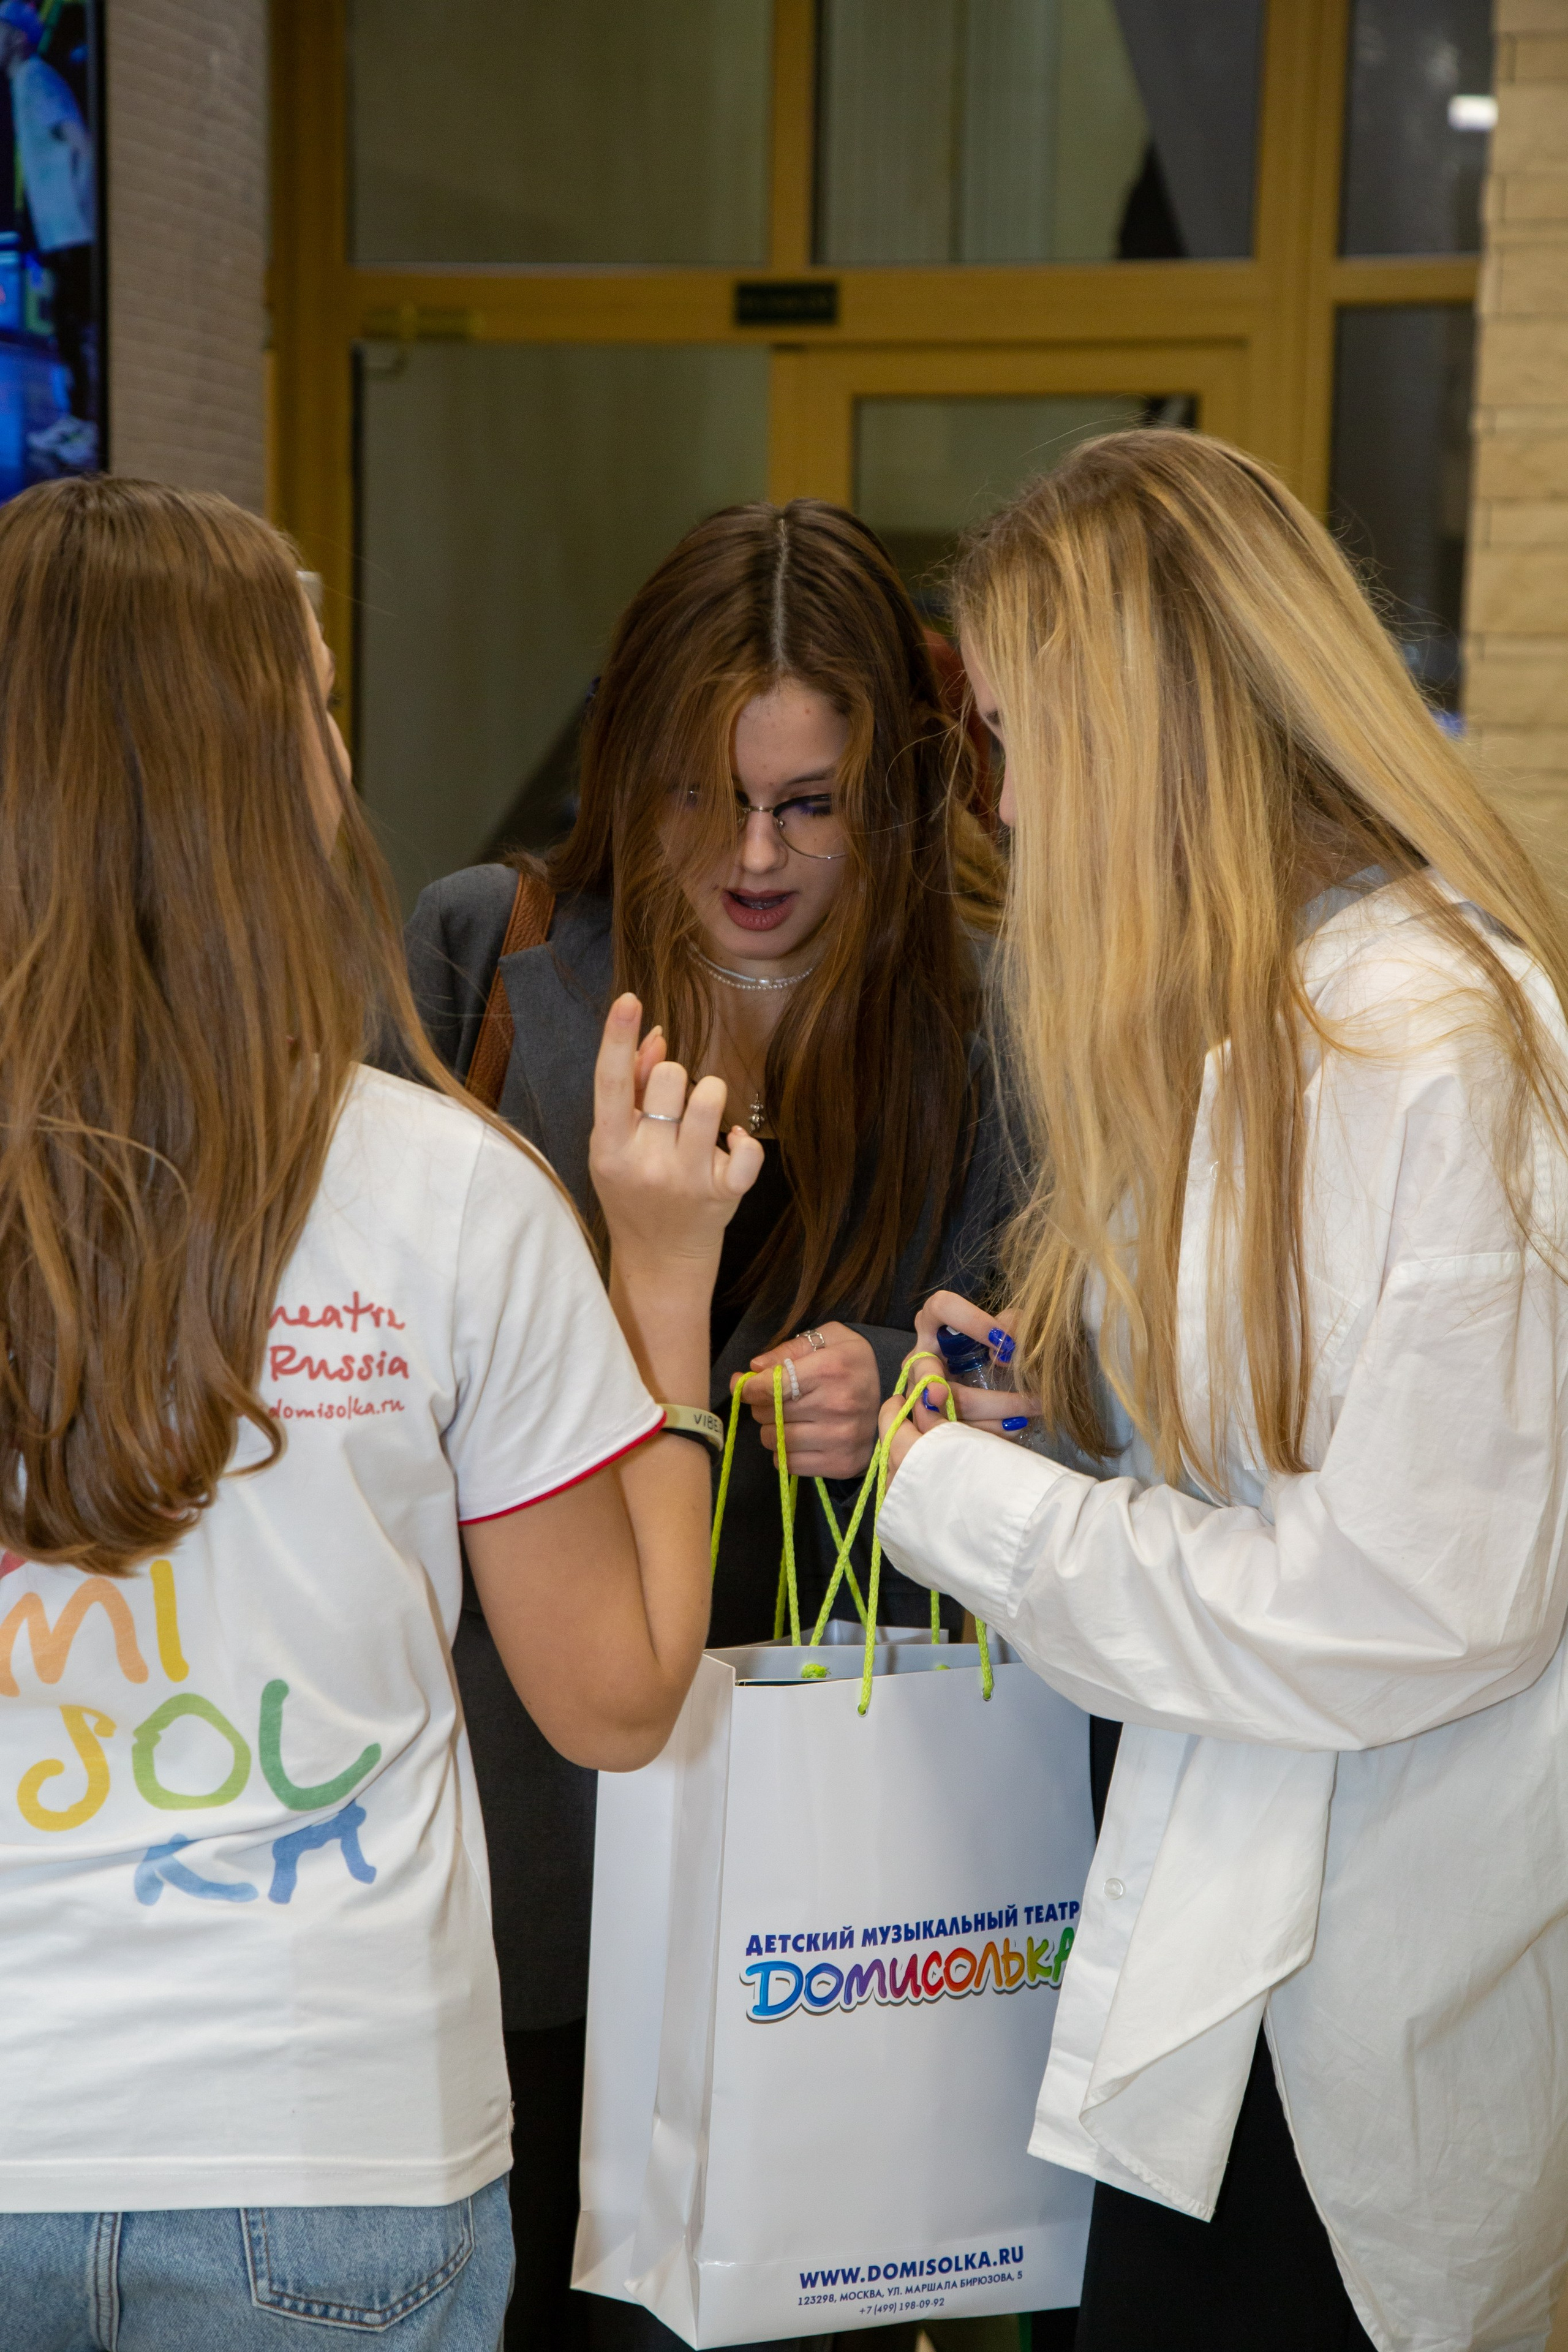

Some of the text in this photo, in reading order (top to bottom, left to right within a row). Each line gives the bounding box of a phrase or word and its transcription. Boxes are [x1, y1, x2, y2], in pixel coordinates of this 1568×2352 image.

[270, 1345, 409, 1382] Russia
[268, 1395, 405, 1420] domisolka.ru
[693, 1413, 722, 1434] VIBE
[17, 1679, 382, 1832] SOL
[745, 1900, 1080, 1956] ДЕТСКИЙ МУЗЫКАЛЬНЫЙ ТЕАТР
[799, 2245, 1024, 2289] WWW.DOMISOLKA.RU
[797, 2271, 1023, 2306] 123298, МОСКВА, УЛ. МАРШАЛА БИРЮЗОВА, 5
[859, 2297, 945, 2316] +7 (499) 198-09-92
